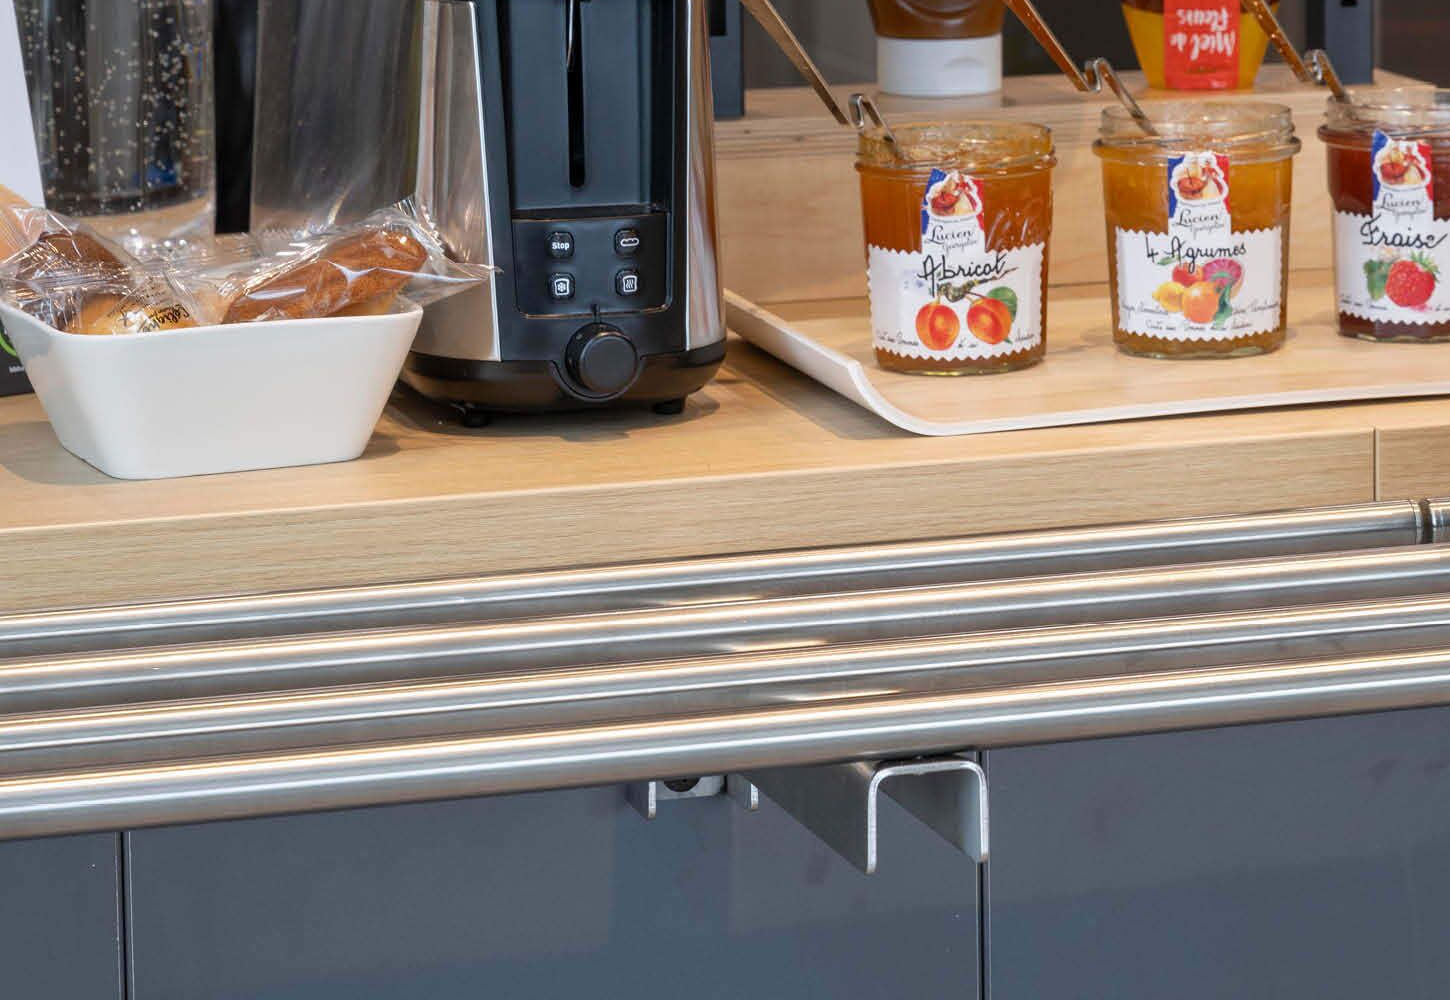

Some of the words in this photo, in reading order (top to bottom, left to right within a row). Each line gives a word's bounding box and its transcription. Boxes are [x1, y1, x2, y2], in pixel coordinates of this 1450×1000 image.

[1170, 31, 1188, 52] de
[1189, 29, 1235, 61] Miel
[1175, 208, 1219, 228] Lucien
[1360, 213, 1448, 249] Fraise
[551, 241, 570, 251] Stop
[928, 224, 974, 245] Lucien
[1145, 236, 1159, 264] 4
[1164, 235, 1247, 274] Agrumes
[916, 252, 1007, 298] Abricot
